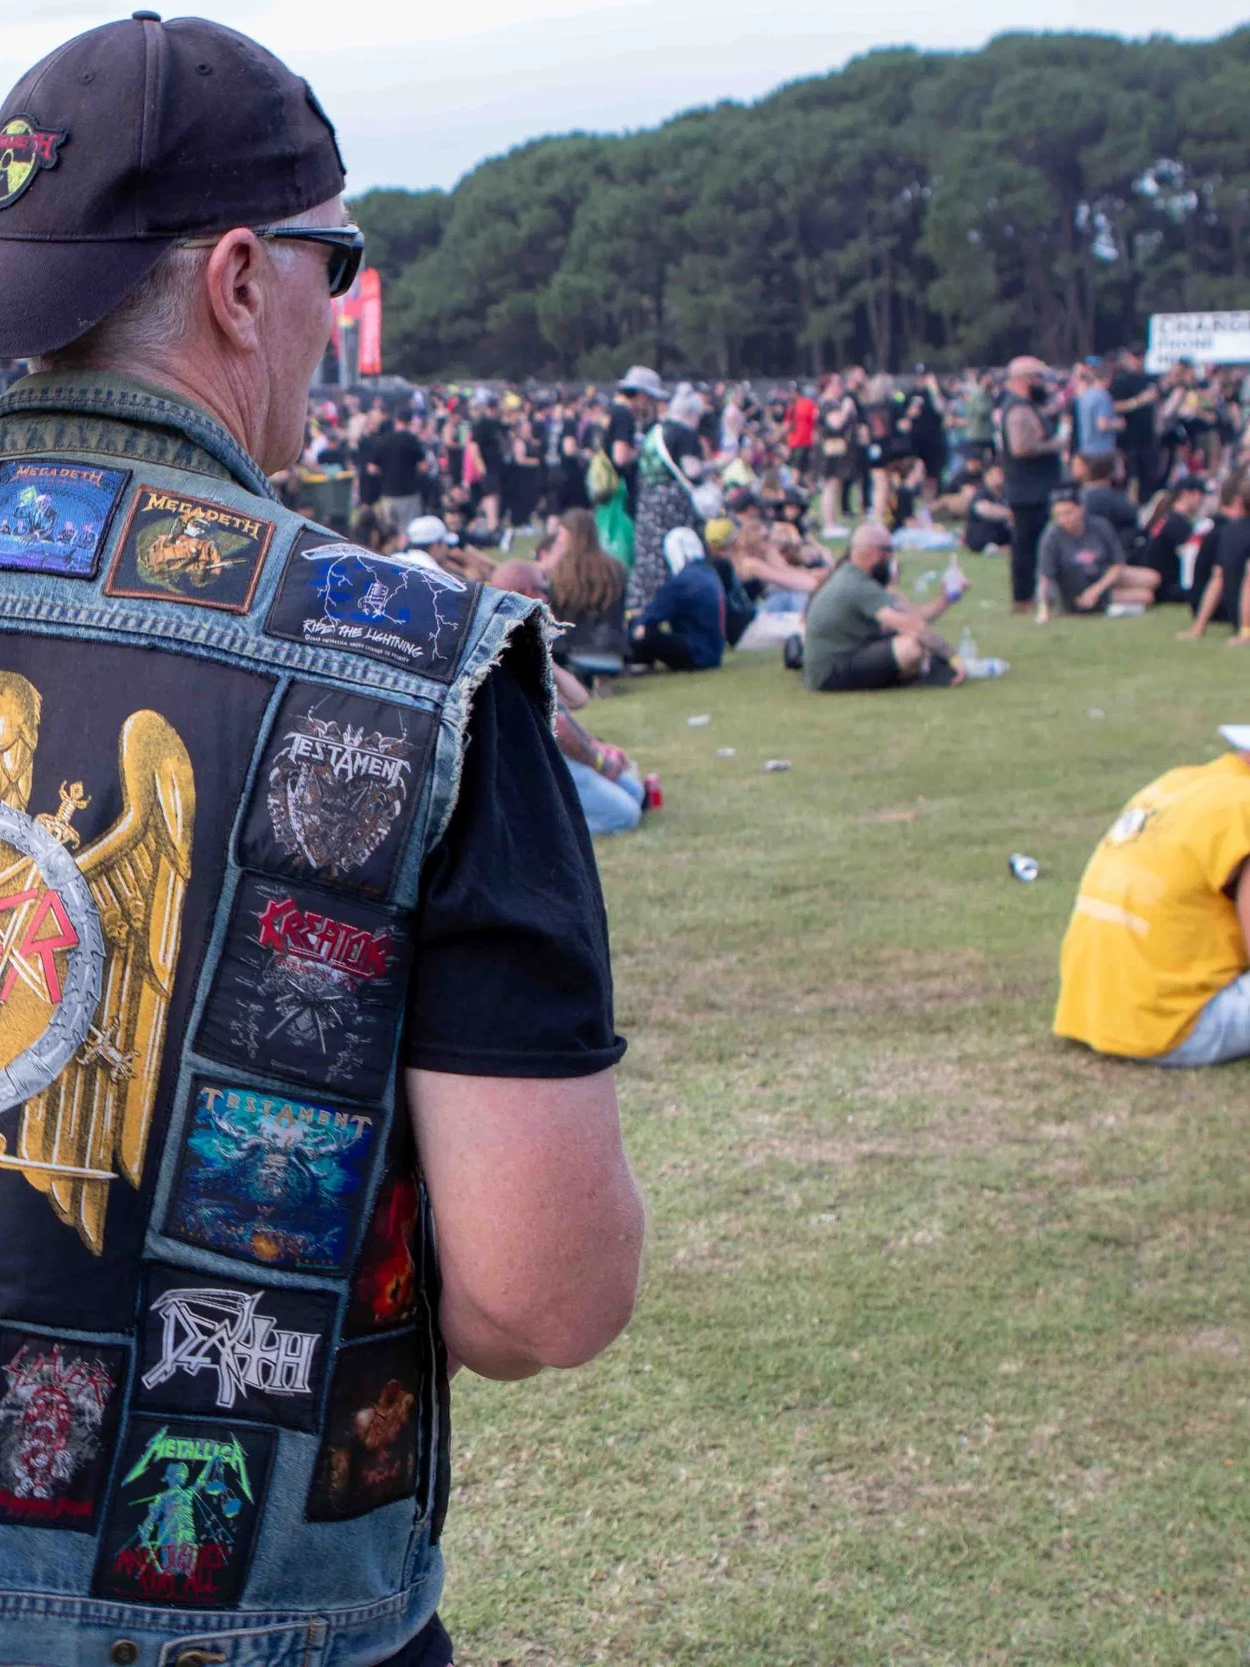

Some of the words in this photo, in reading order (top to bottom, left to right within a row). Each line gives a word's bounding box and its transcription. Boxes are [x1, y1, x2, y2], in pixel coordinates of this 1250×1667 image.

[10, 465, 105, 488] MEGADETH
[142, 493, 263, 541] MEGADETH
[302, 619, 336, 635] RIDE
[338, 624, 365, 640] THE
[363, 628, 424, 658] LIGHTNING
[283, 731, 411, 789] TESTAMENT
[259, 898, 392, 980] KREATOR
[200, 1087, 372, 1138] TESTAMENT
[121, 1425, 255, 1505] METALLICA
